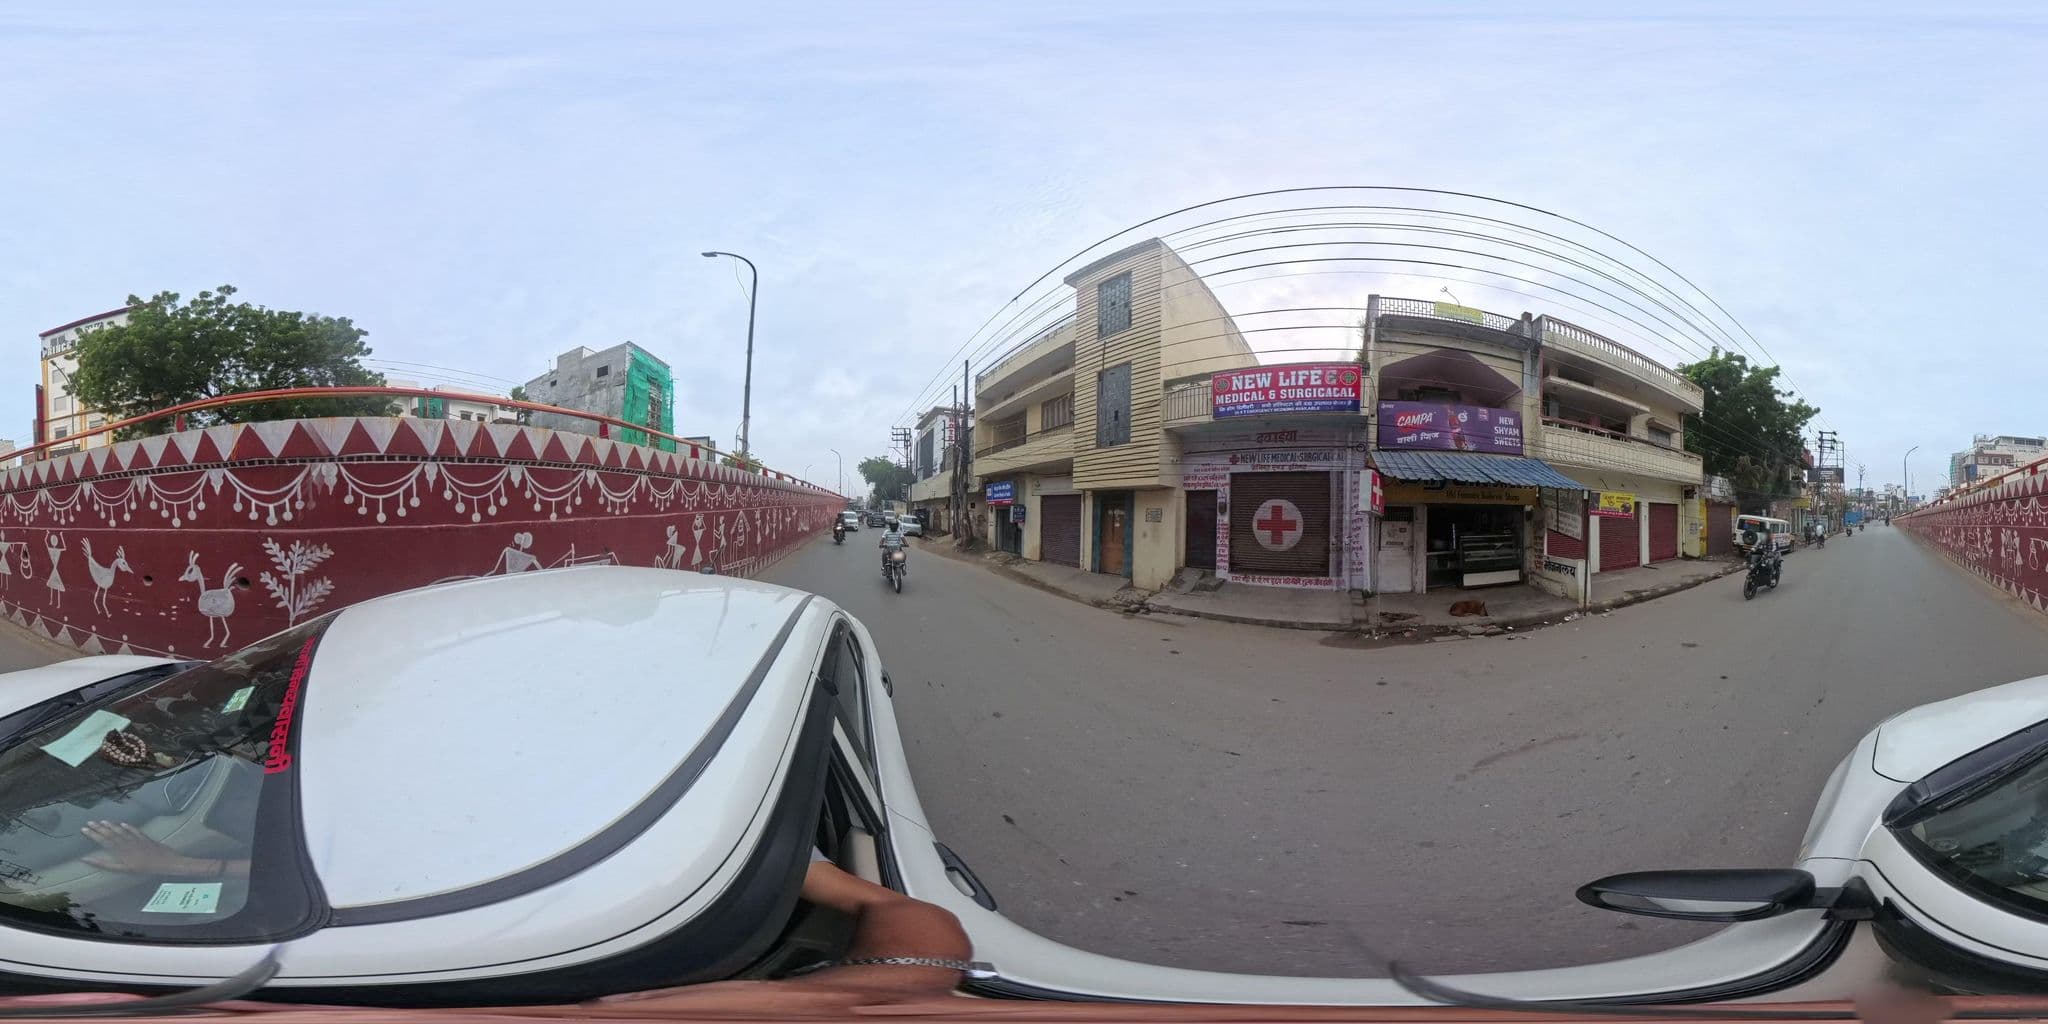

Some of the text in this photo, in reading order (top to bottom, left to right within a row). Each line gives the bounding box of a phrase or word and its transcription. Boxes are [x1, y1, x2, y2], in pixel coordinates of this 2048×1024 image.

[1232, 369, 1322, 391] NEW LIFE
[1215, 391, 1265, 405] MEDICAL
[1397, 412, 1433, 427] CAMPA
[1499, 416, 1514, 425] NEW
[1494, 427, 1519, 437] SHYAM
[1494, 437, 1520, 447] SWEETS
